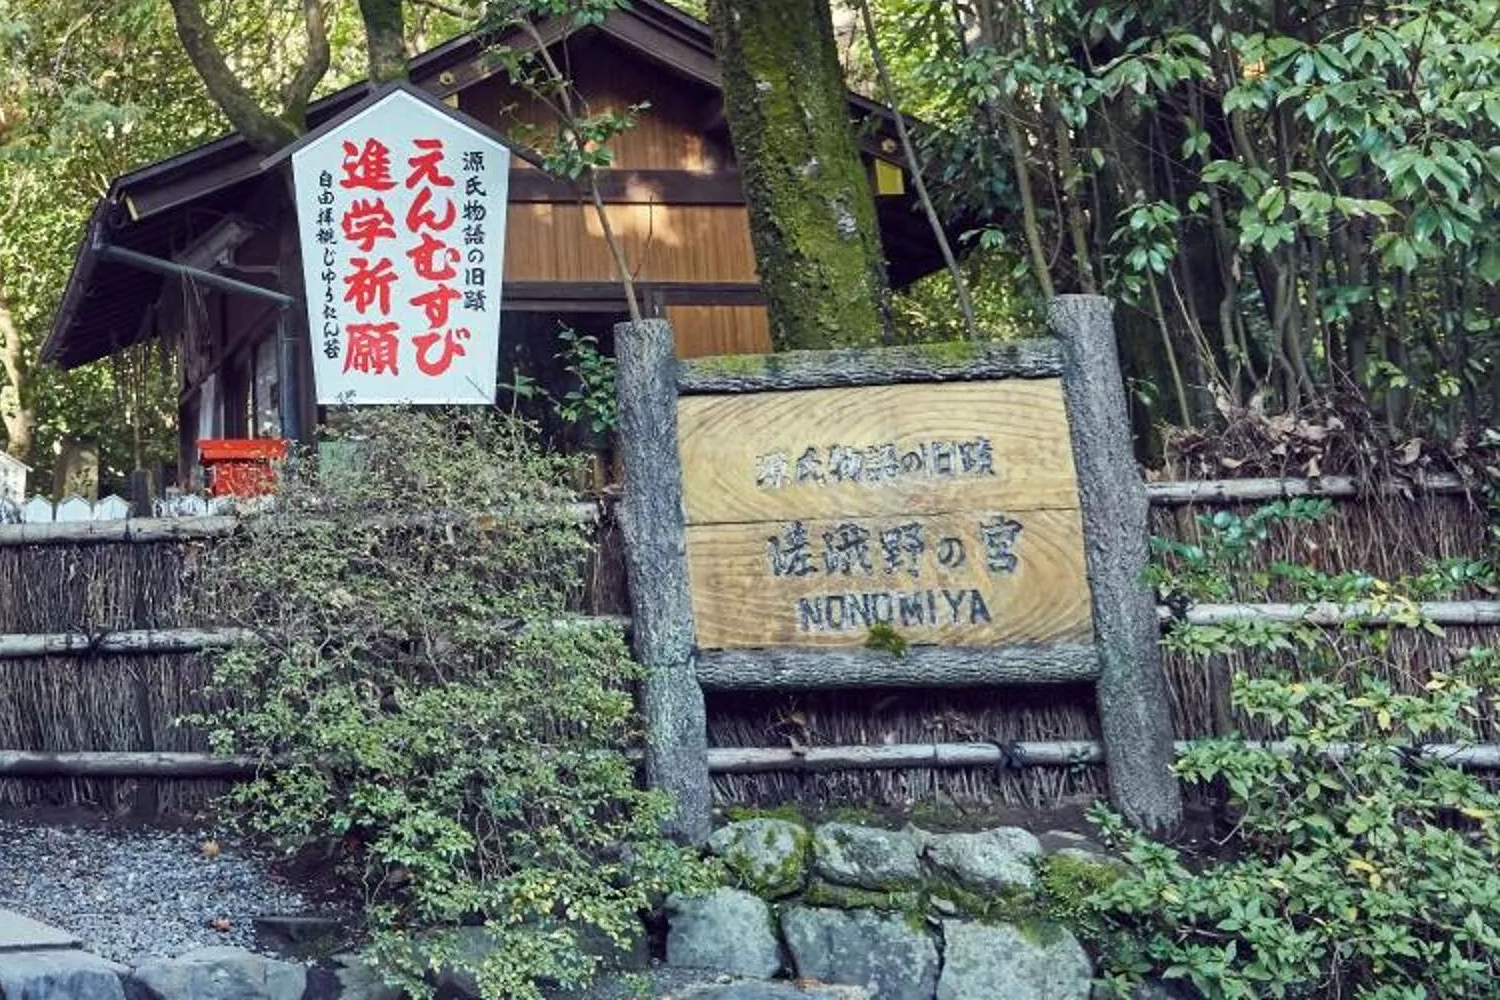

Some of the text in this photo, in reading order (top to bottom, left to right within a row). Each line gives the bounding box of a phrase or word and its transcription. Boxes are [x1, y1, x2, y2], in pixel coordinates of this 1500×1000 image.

[339, 137, 400, 376] 進学祈願
[405, 138, 470, 376] えんむすび
[767, 515, 1023, 577] 嵯峨野の宮
[798, 589, 991, 632] NONOMIYA
